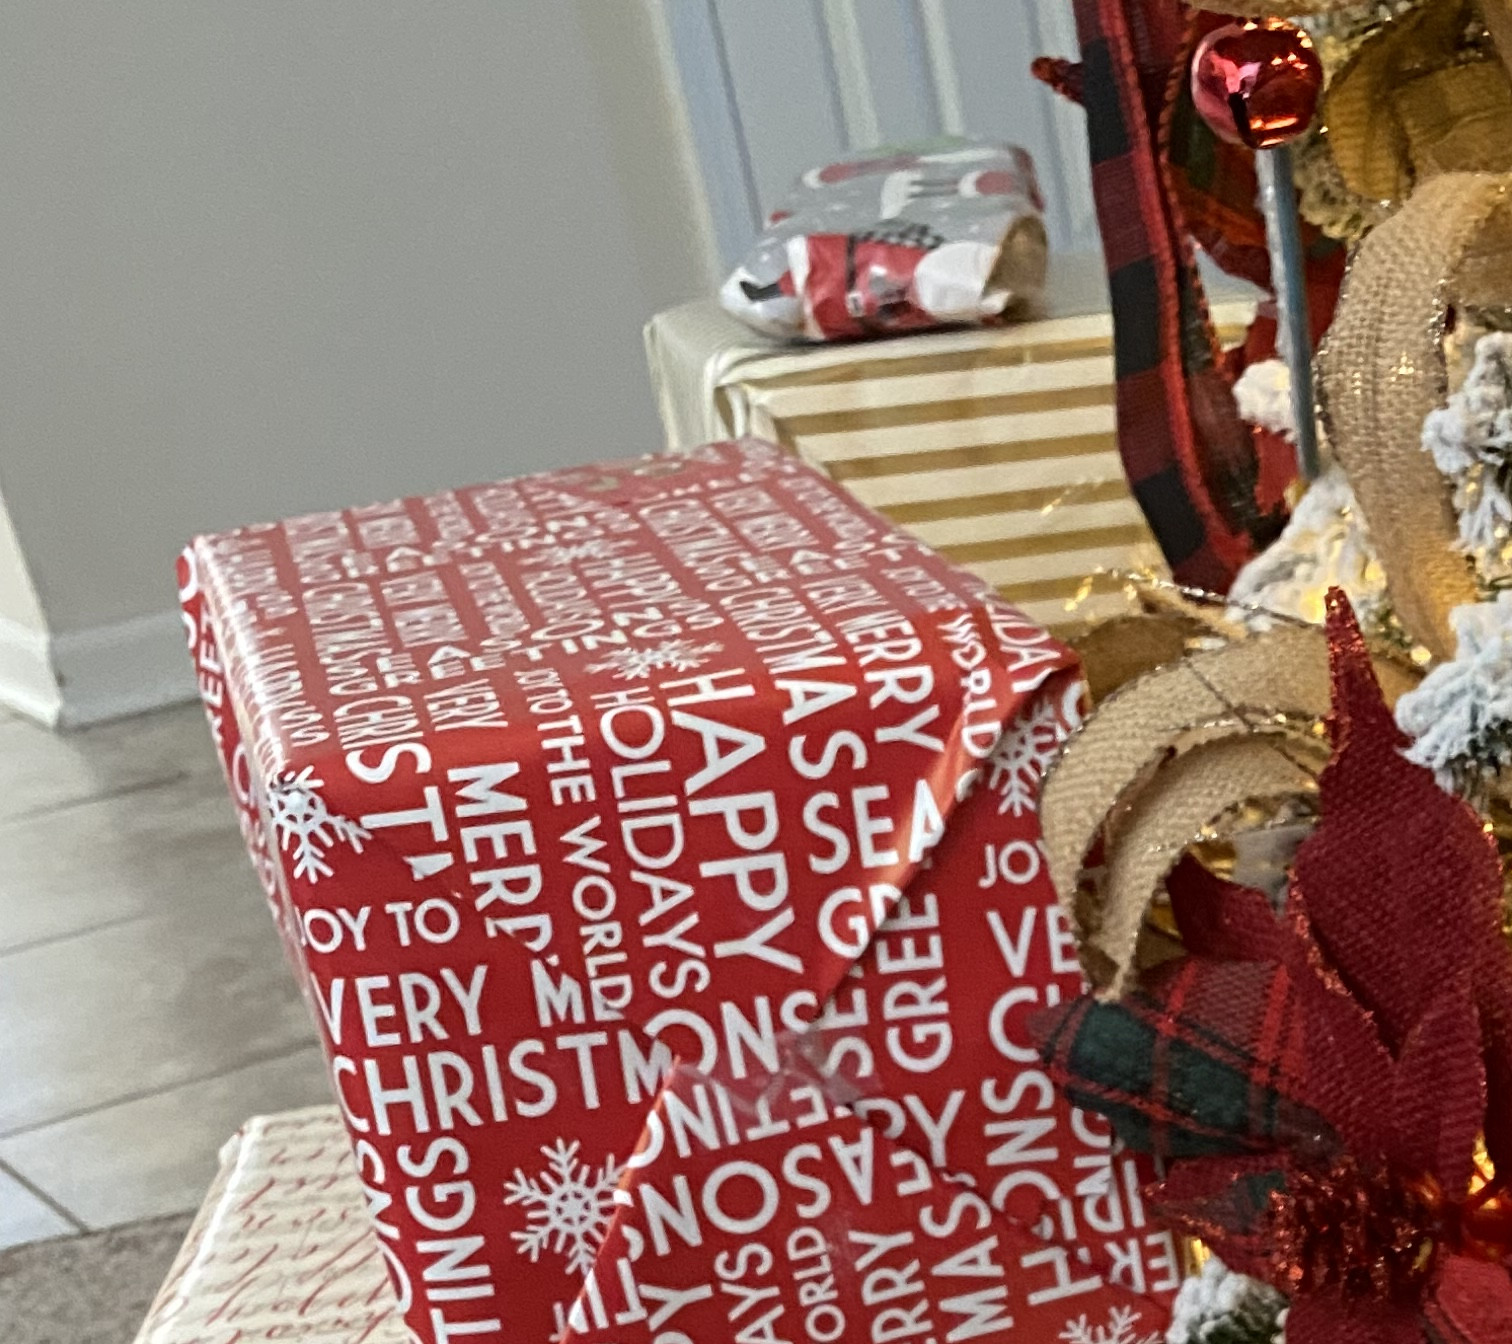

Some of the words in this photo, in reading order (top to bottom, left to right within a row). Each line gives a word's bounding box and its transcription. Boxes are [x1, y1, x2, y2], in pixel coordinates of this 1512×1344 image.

[422, 679, 509, 731] VERY
[538, 716, 597, 806] THE
[720, 587, 868, 780] CHRISTMAS
[836, 609, 945, 752] MERRY
[448, 762, 556, 953] MERR
[590, 686, 711, 998] HOLIDAYS
[660, 668, 803, 975] HAPPY
[385, 898, 460, 947] TO
[560, 816, 635, 1021] WORLD
[310, 964, 489, 1048] VERY
